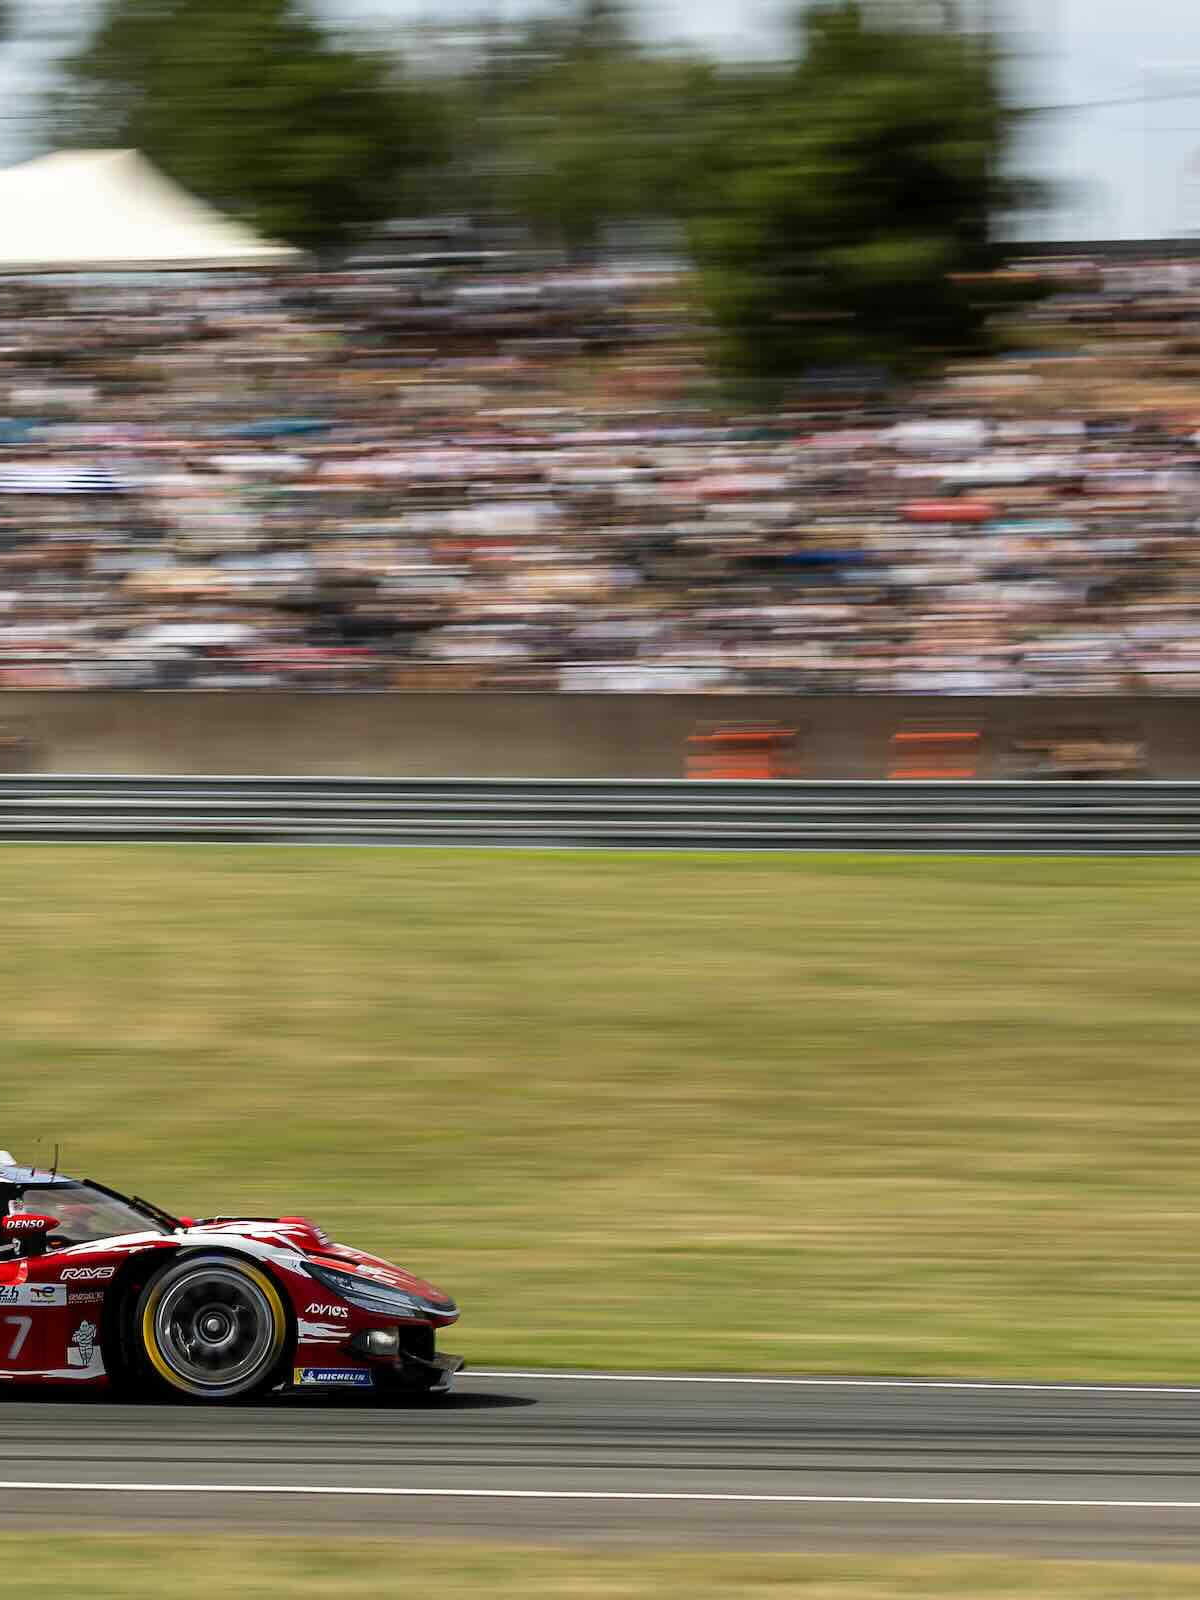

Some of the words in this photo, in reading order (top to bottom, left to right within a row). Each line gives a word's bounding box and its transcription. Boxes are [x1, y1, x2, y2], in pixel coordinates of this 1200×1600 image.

[6, 1219, 45, 1230] DENSO
[60, 1266, 115, 1281] RAYS
[3, 1315, 32, 1360] 7
[317, 1373, 366, 1381] MICHELIN
